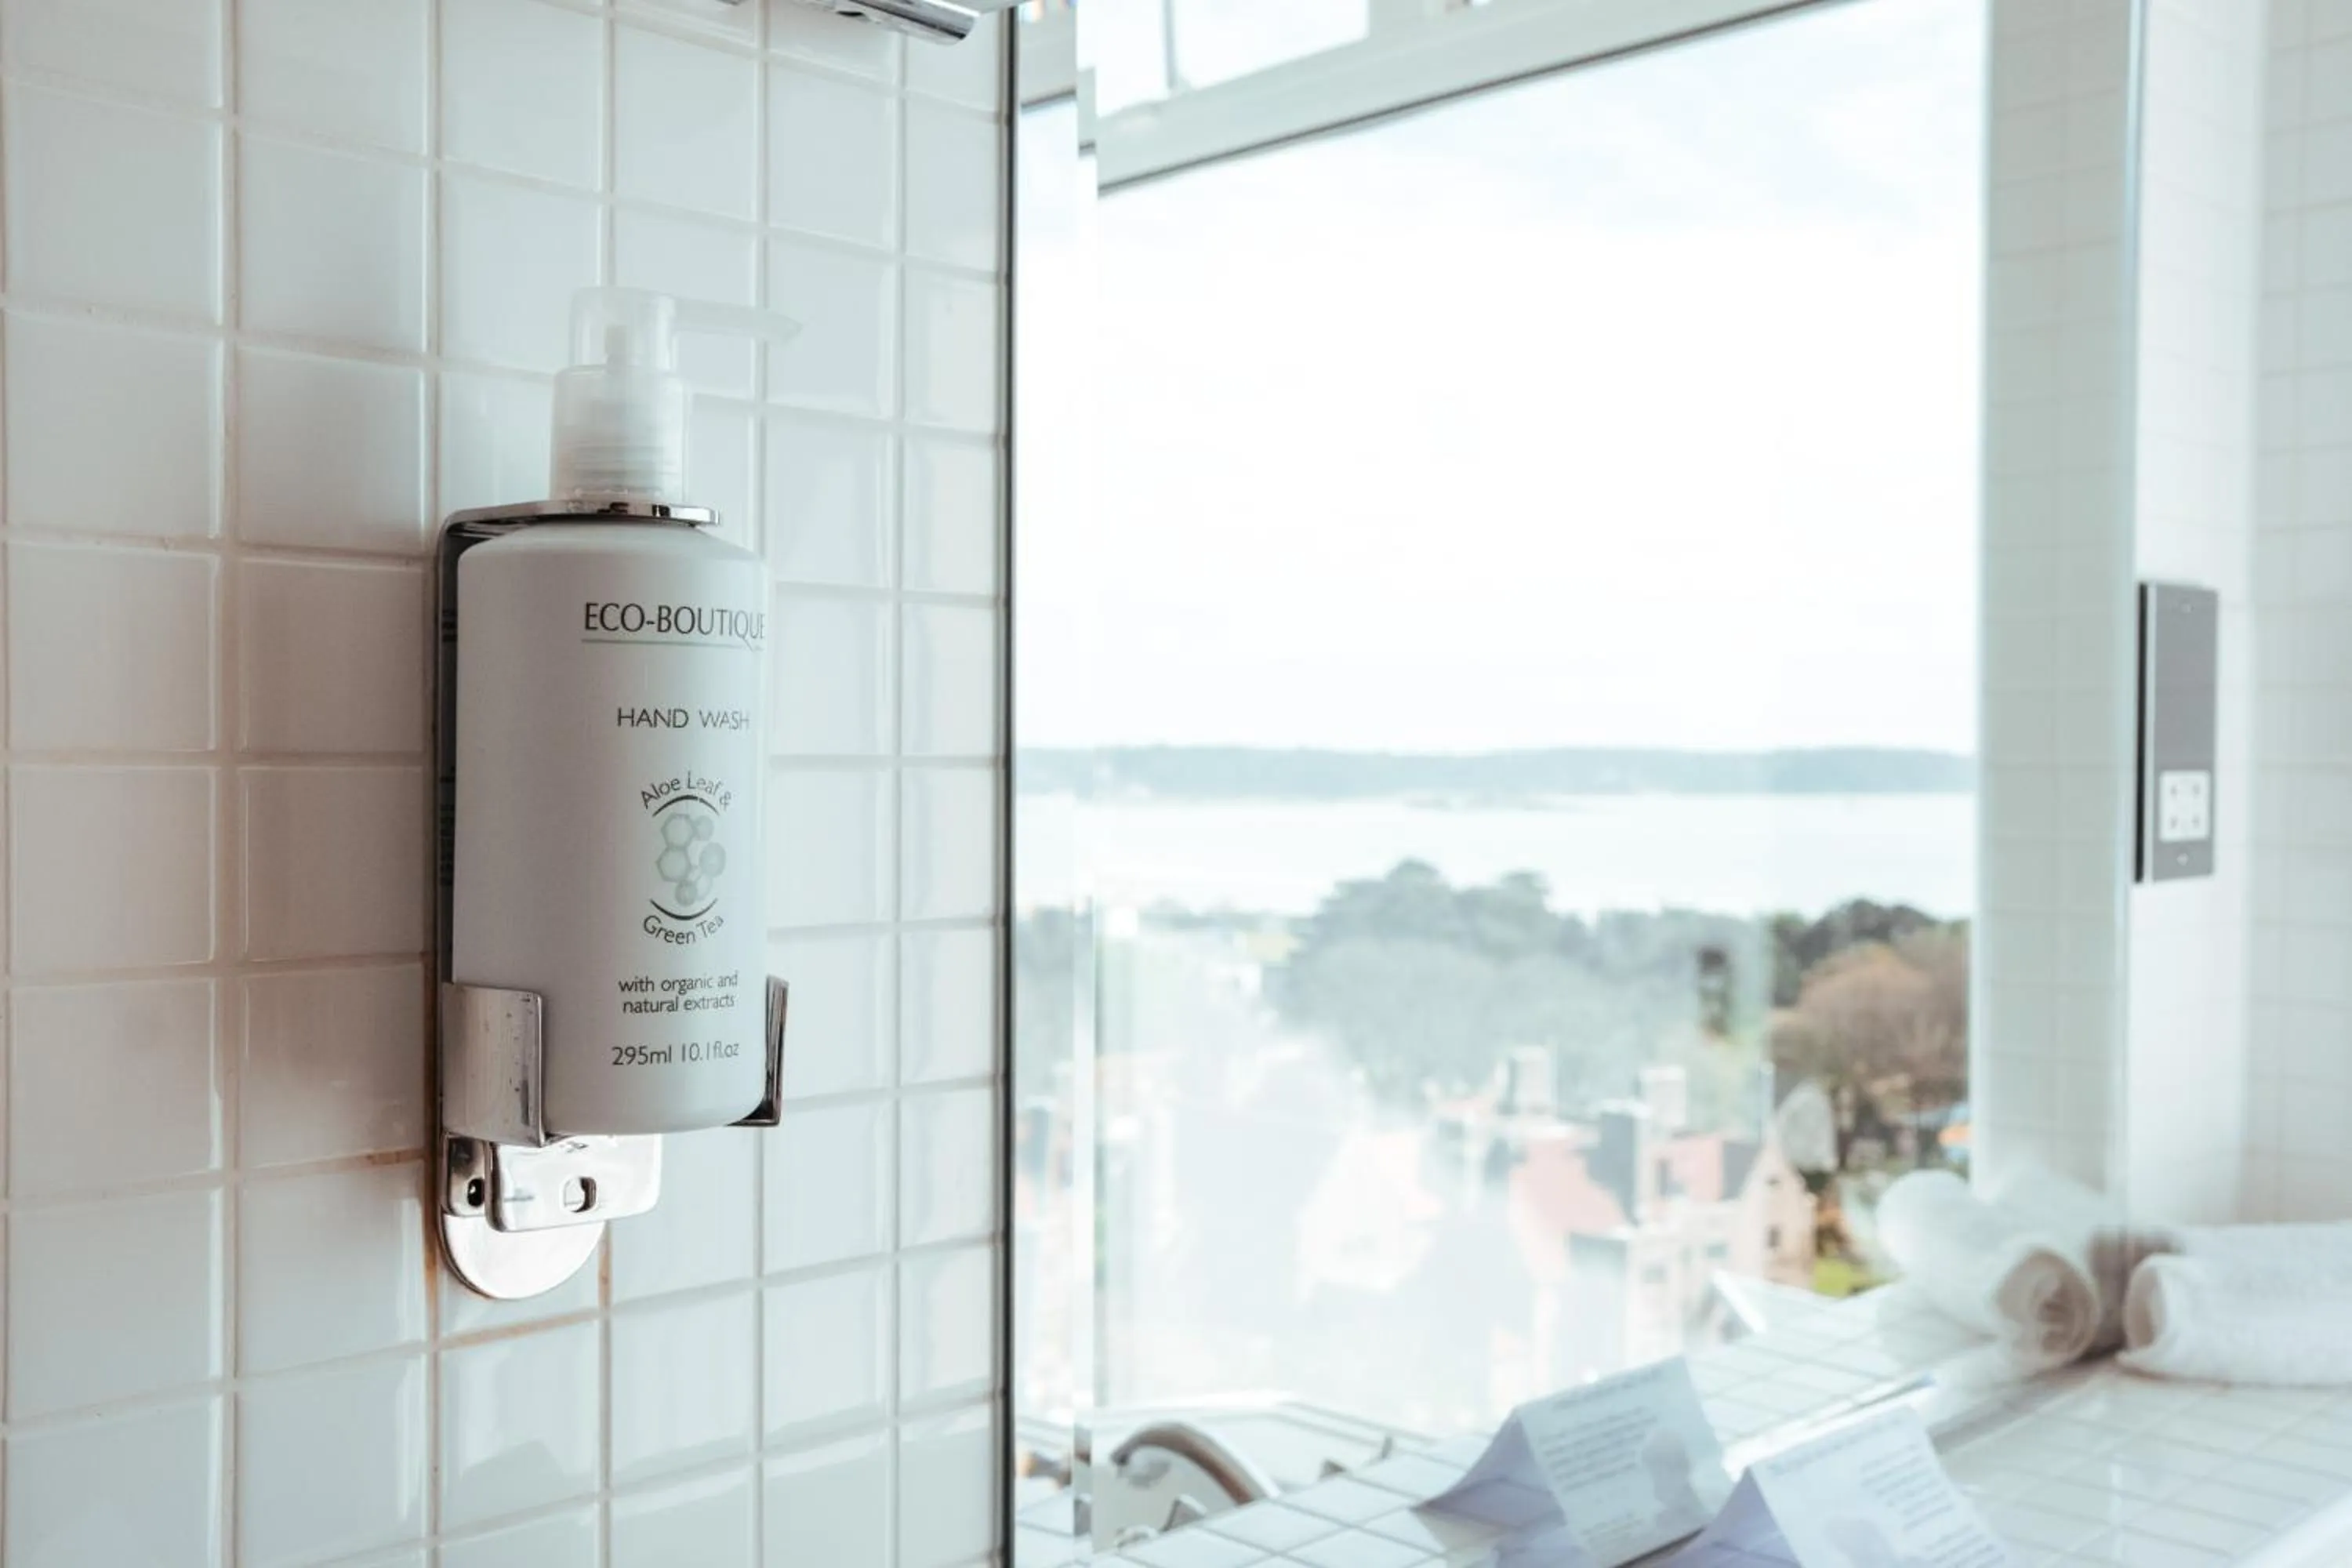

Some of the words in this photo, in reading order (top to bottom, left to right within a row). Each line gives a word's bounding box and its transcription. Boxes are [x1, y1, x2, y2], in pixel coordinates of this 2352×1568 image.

[584, 601, 765, 652] ECO-BOUTIQUE
[617, 707, 689, 728] HAND
[699, 709, 750, 730] WASH
[641, 778, 681, 809] Aloe
[687, 770, 721, 797] Leaf
[719, 790, 732, 811] &
[643, 914, 696, 945] Green
[696, 914, 724, 938] Tea
[619, 975, 655, 993] with
[661, 976, 713, 996] organic
[717, 971, 739, 988] and
[622, 996, 679, 1014] natural
[684, 994, 735, 1011] extracts
[612, 1044, 672, 1065] 295ml
